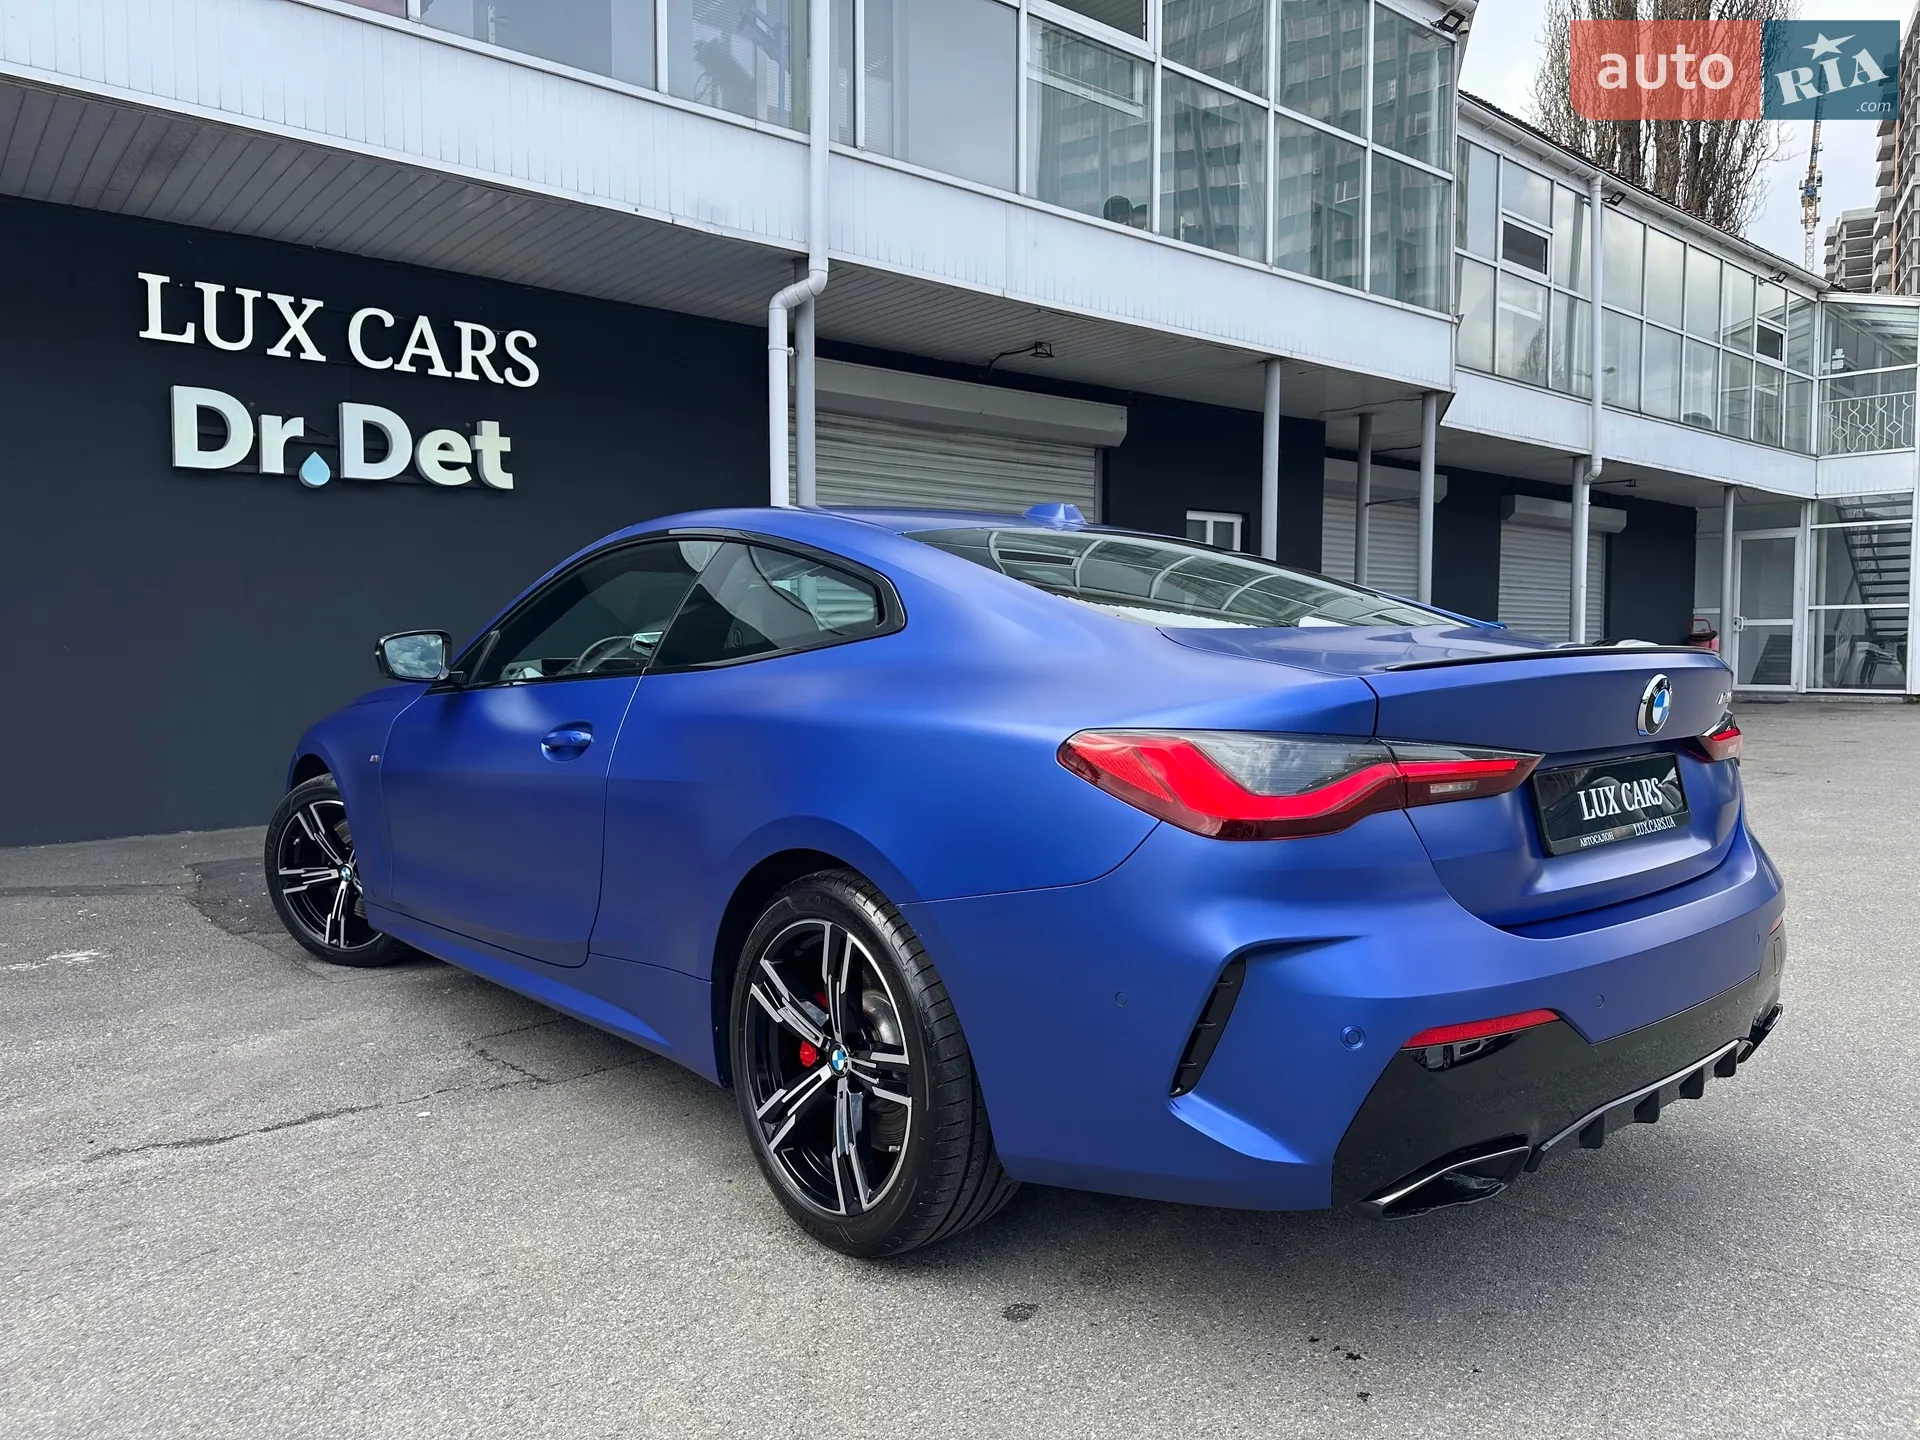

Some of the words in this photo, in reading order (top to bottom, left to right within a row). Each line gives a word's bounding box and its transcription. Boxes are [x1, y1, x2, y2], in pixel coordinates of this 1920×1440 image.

[138, 271, 327, 363] LUX
[348, 307, 540, 388] CARS
[1577, 785, 1621, 820] LUX
[1621, 777, 1663, 811] CARS
